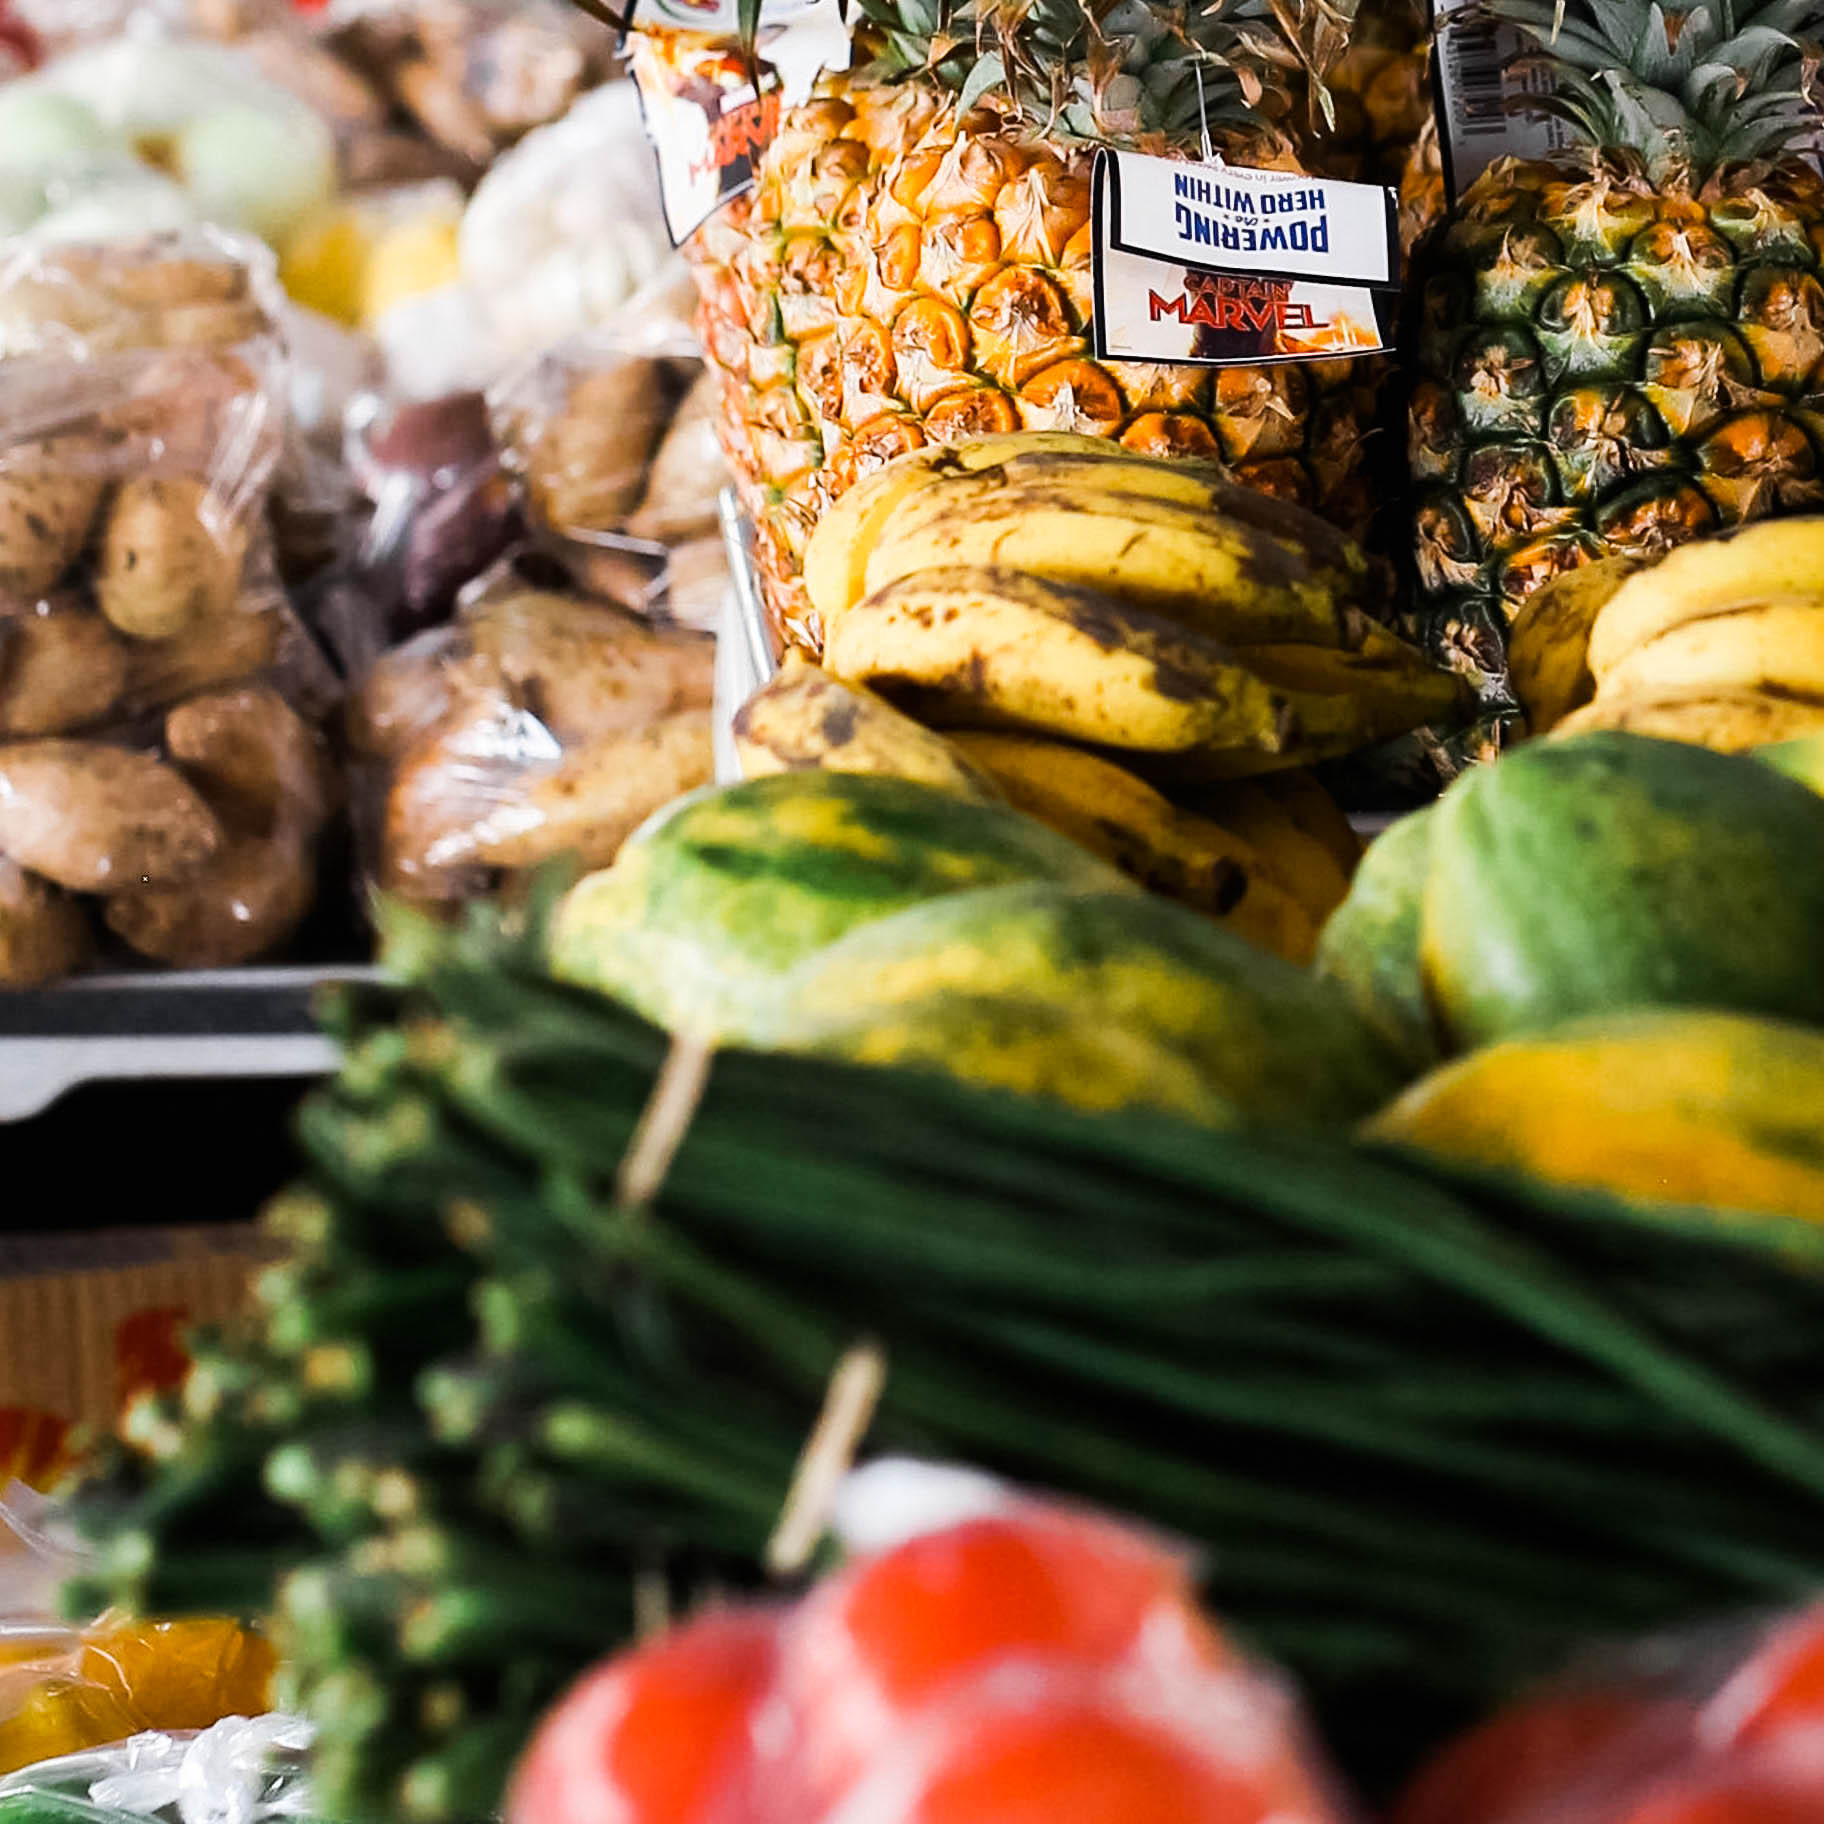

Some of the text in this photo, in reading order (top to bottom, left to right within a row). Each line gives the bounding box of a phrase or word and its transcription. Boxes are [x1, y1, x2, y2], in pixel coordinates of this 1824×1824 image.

[1174, 172, 1326, 215] HERO WITHIN
[1174, 201, 1329, 253] POWERING
[1183, 272, 1290, 302] CAPTAIN
[1148, 288, 1331, 332] MARVEL
